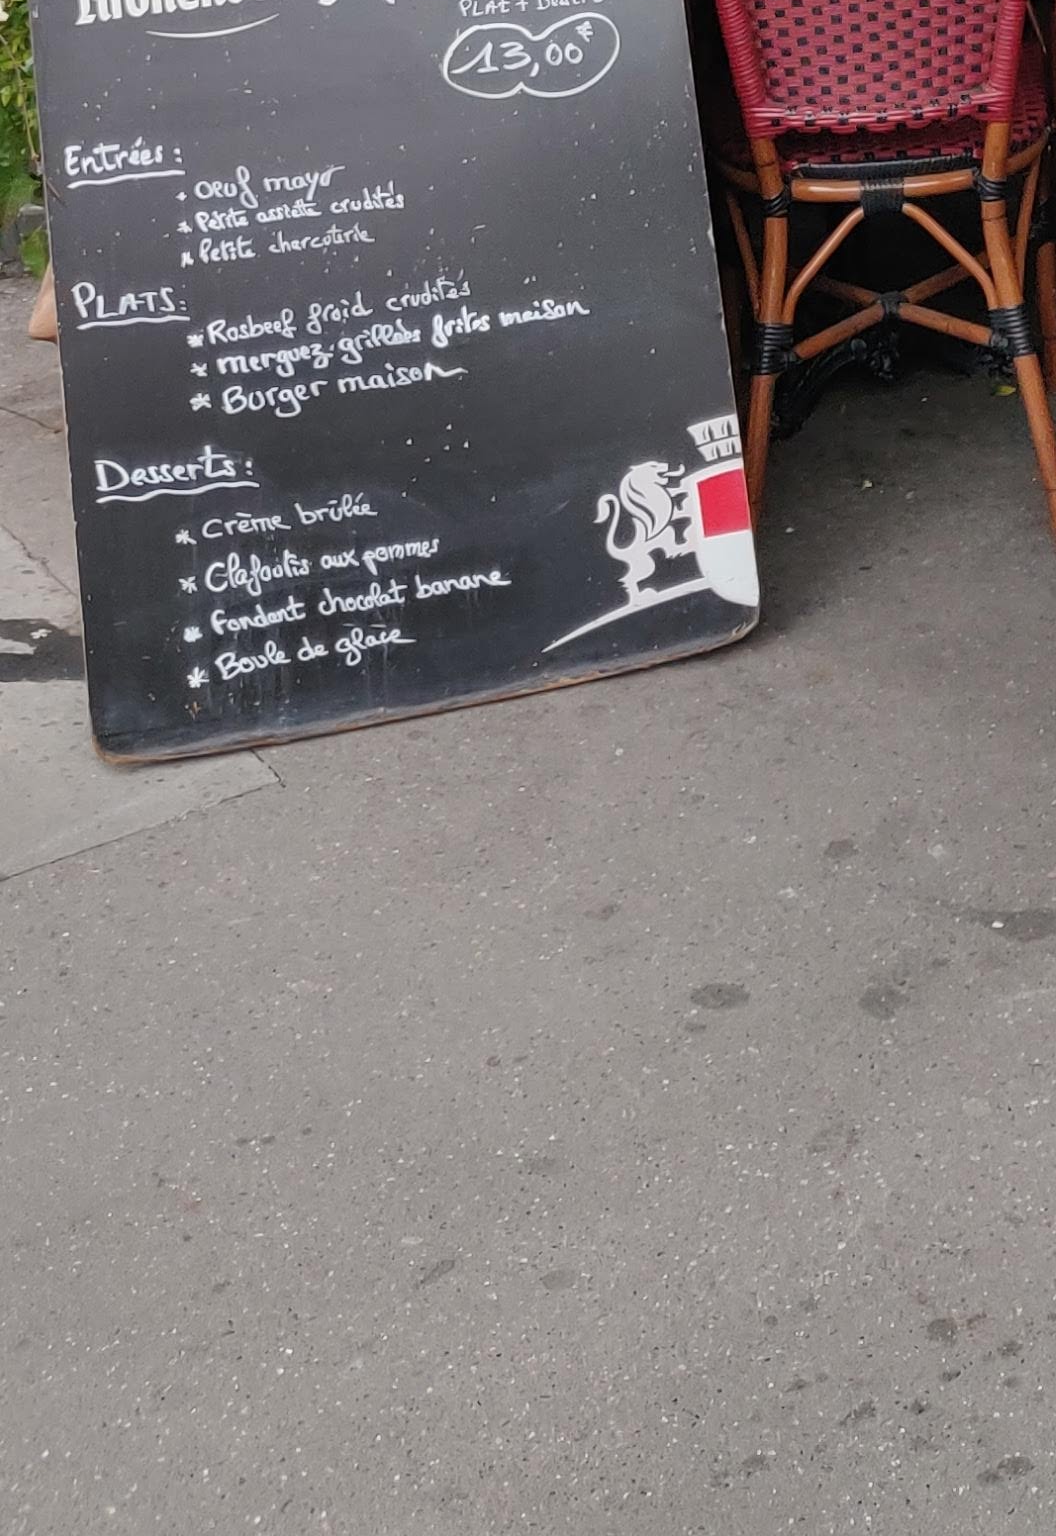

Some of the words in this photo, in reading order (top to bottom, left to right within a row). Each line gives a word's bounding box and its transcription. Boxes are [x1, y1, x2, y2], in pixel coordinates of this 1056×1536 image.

[306, 290, 373, 335] froid
[221, 380, 328, 418] Burger
[337, 362, 469, 394] maison
[320, 549, 360, 570] aux
[318, 579, 408, 616] chocolat
[415, 569, 512, 599] banane
[215, 640, 292, 680] Boule
[297, 636, 329, 661] de
